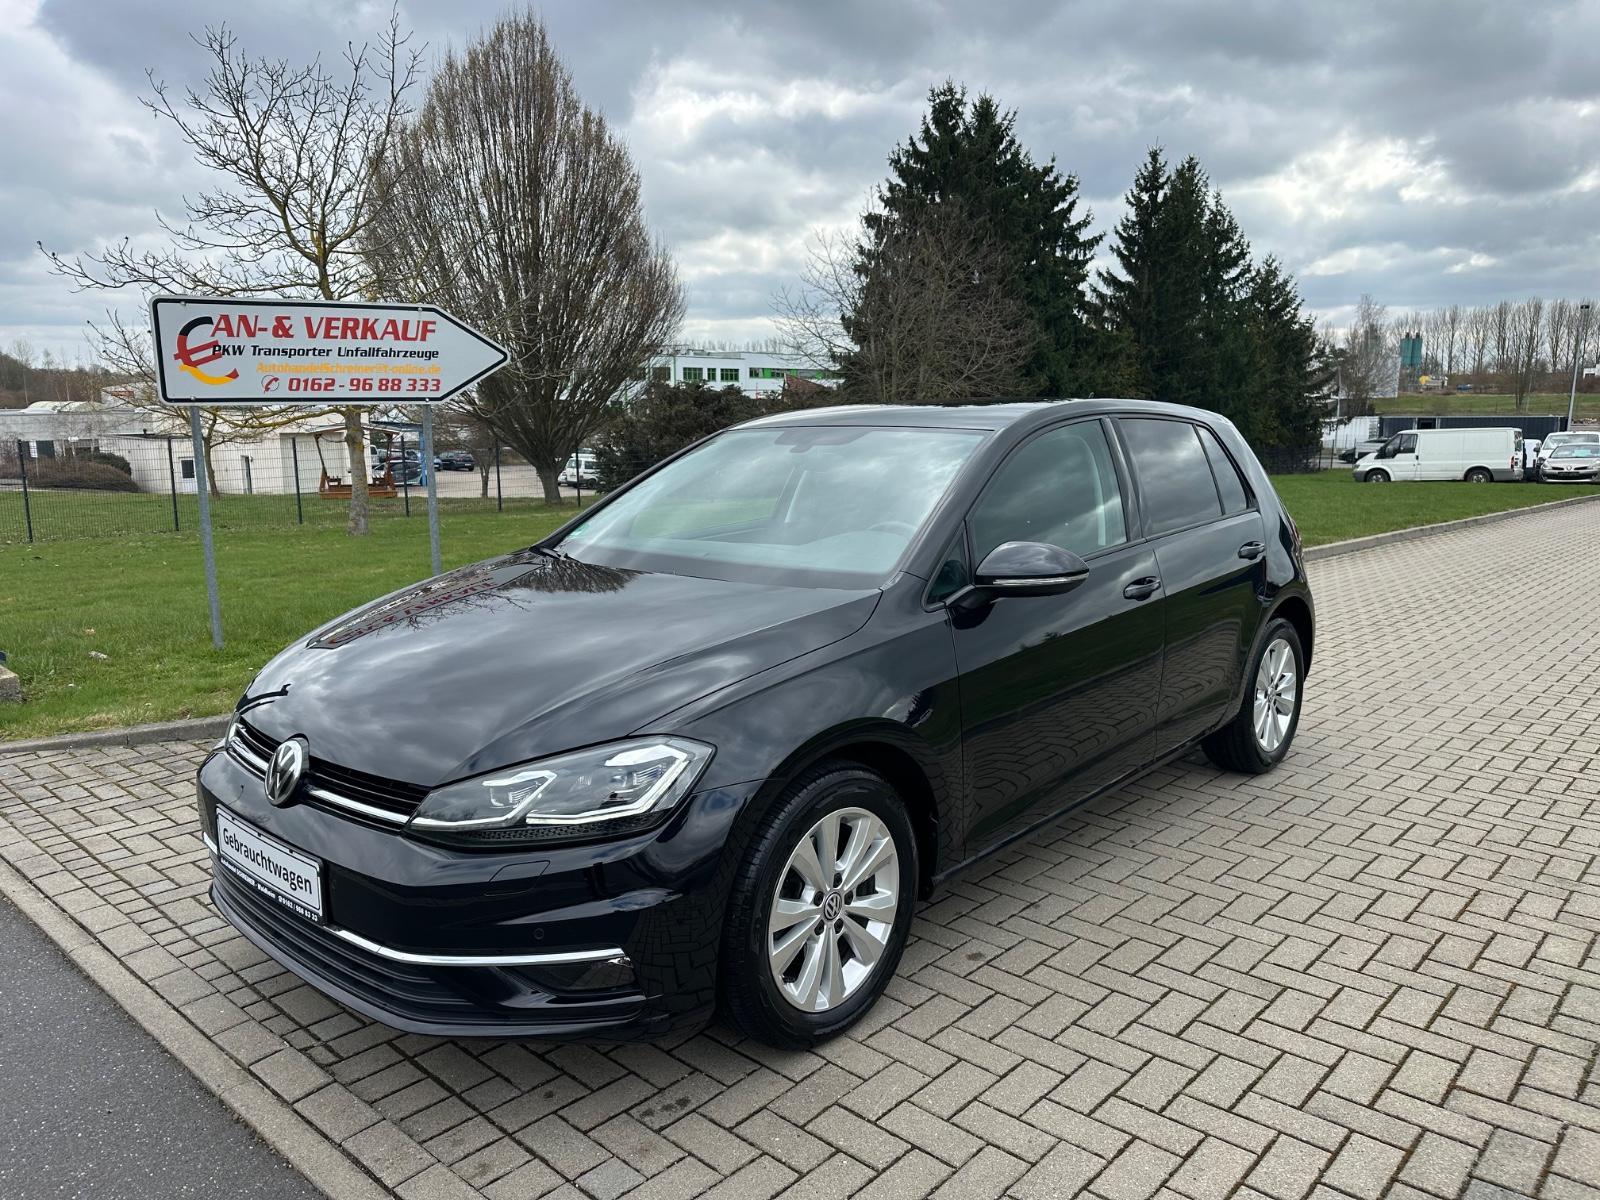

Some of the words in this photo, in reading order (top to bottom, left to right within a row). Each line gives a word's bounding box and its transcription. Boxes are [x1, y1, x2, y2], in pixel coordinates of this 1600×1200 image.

[210, 314, 268, 338] AN-
[271, 315, 295, 338] &
[304, 316, 437, 342] VERKAUF
[212, 344, 246, 356] PKW
[251, 344, 333, 359] Transporter
[337, 346, 440, 361] Unfallfahrzeuge
[288, 377, 336, 392] 0162
[349, 377, 374, 392] 96
[378, 378, 402, 392] 88
[406, 378, 441, 392] 333
[223, 827, 313, 895] Gebrauchtwagen
